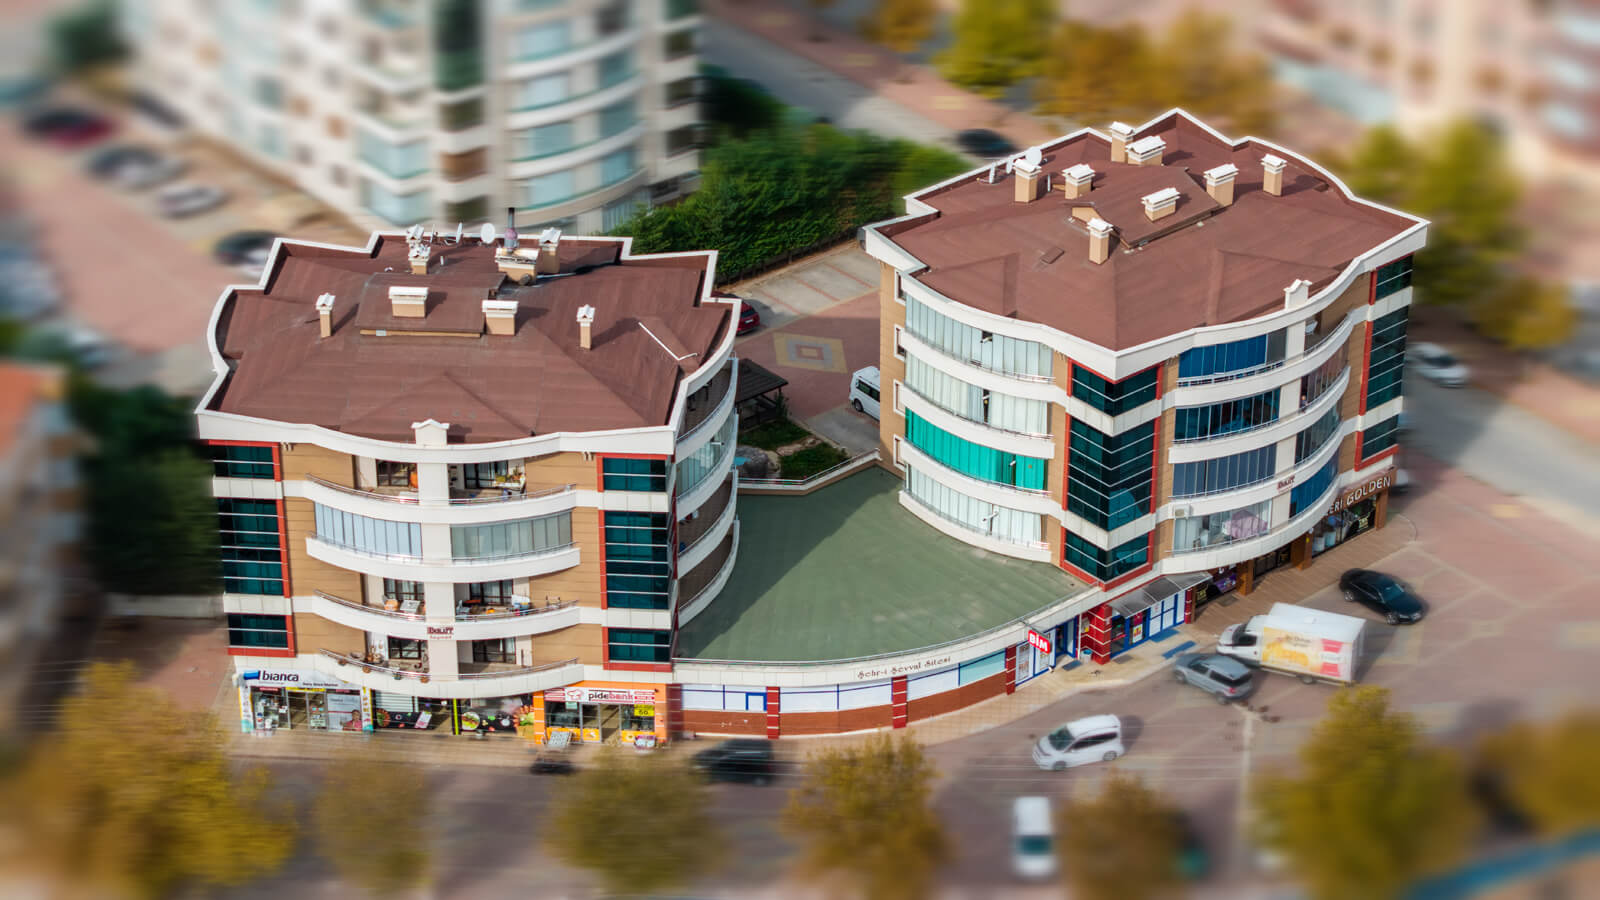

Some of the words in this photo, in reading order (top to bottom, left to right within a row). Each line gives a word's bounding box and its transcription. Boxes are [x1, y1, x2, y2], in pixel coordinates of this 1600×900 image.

[1345, 475, 1391, 506] GOLDEN
[262, 670, 299, 682] bianca
[588, 689, 633, 702] pidebank
